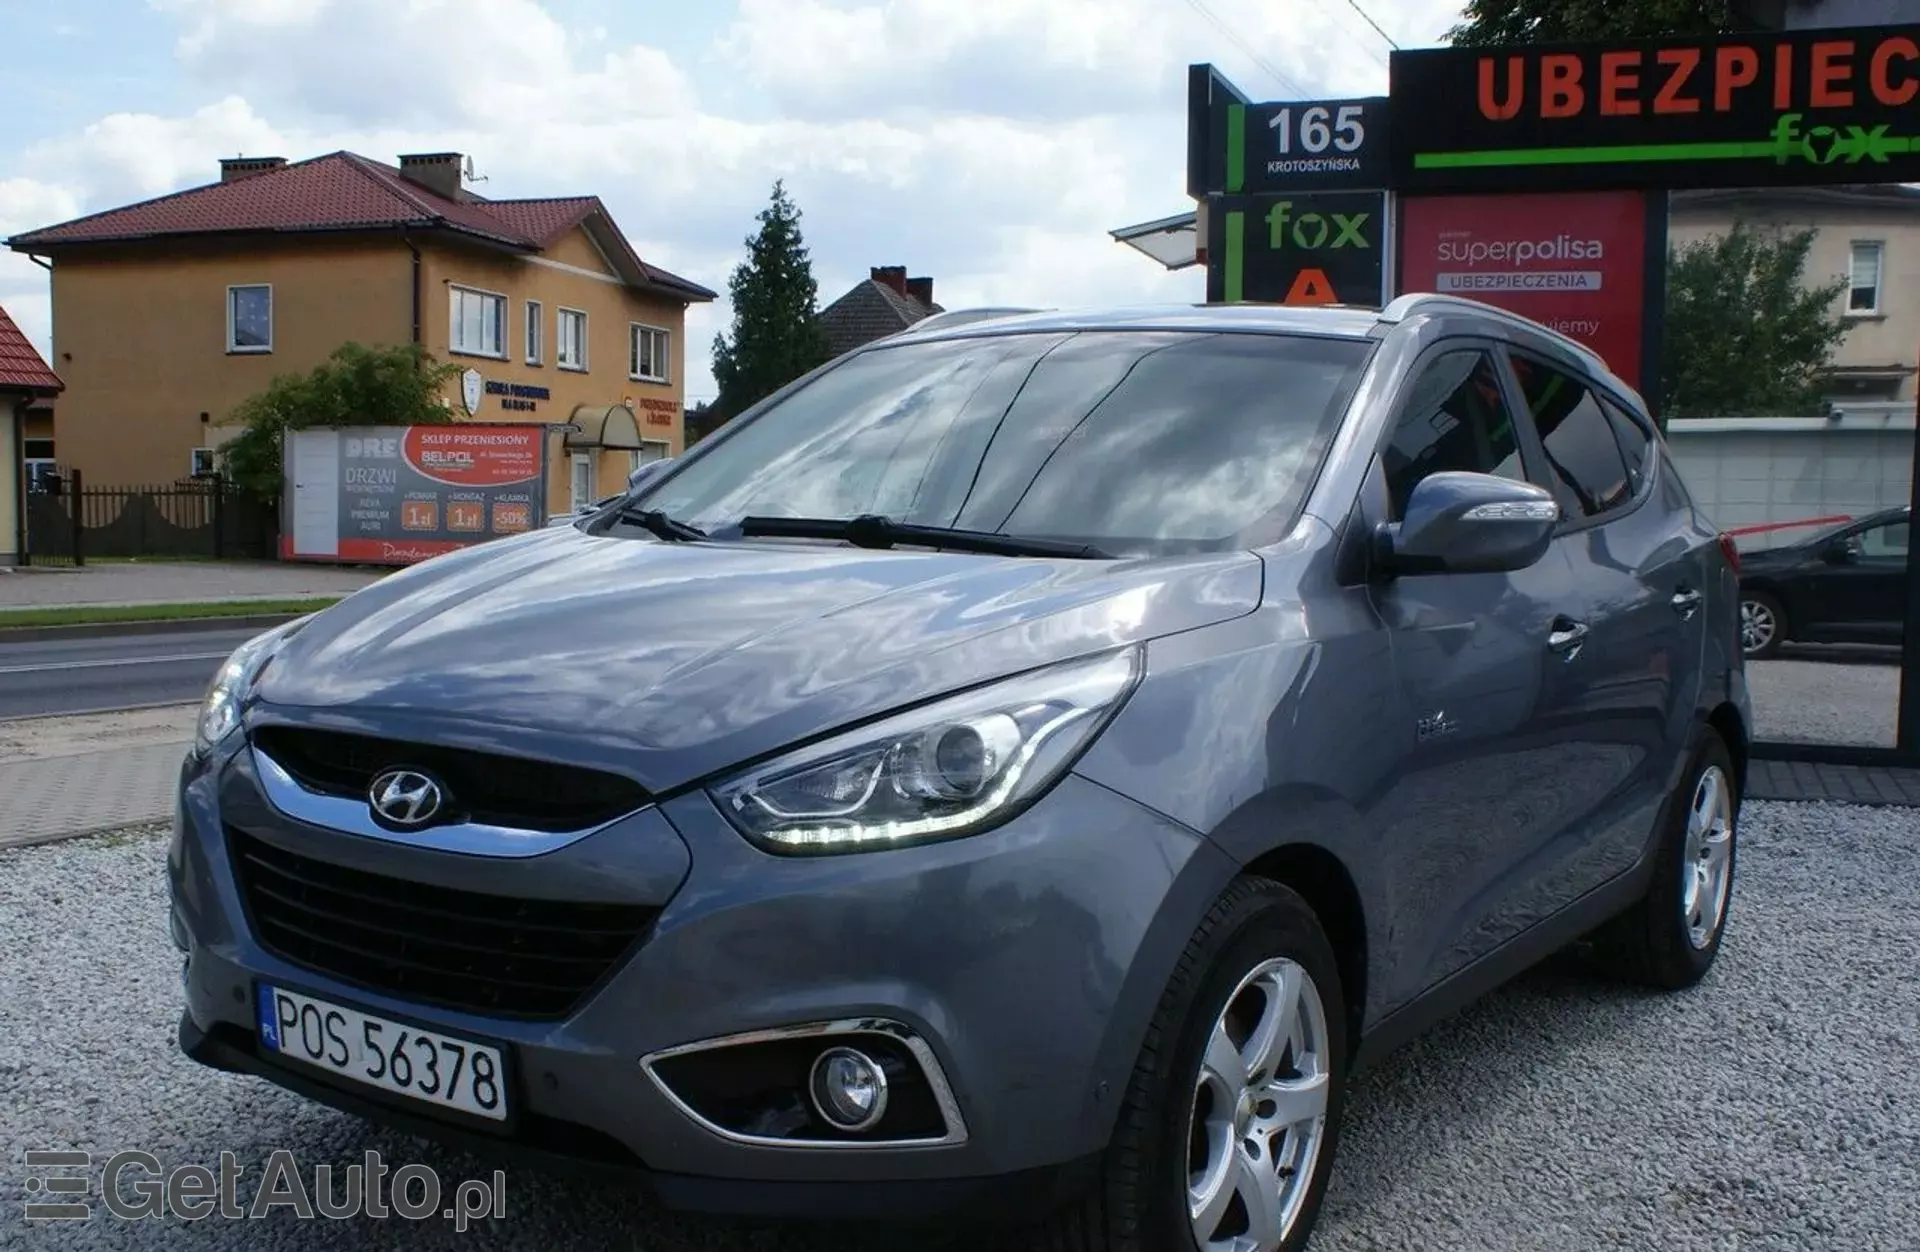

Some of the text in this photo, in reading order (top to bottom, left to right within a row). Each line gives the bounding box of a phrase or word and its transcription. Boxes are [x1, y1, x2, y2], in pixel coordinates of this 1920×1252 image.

[1477, 36, 1920, 121] UBEZPIEC
[1269, 105, 1365, 154] 165
[1770, 113, 1890, 165] fox
[1267, 156, 1360, 174] KROTOSZYŃSKA
[1265, 202, 1371, 249] fox
[1438, 234, 1603, 266] superpolisa
[1450, 274, 1588, 290] UBEZPIECZENIA
[422, 434, 529, 445] SKLEP PRZENIESIONY
[345, 467, 396, 484] DRZWI
[410, 508, 420, 526] 1
[455, 507, 465, 526] 1
[277, 993, 499, 1110] POS 56378
